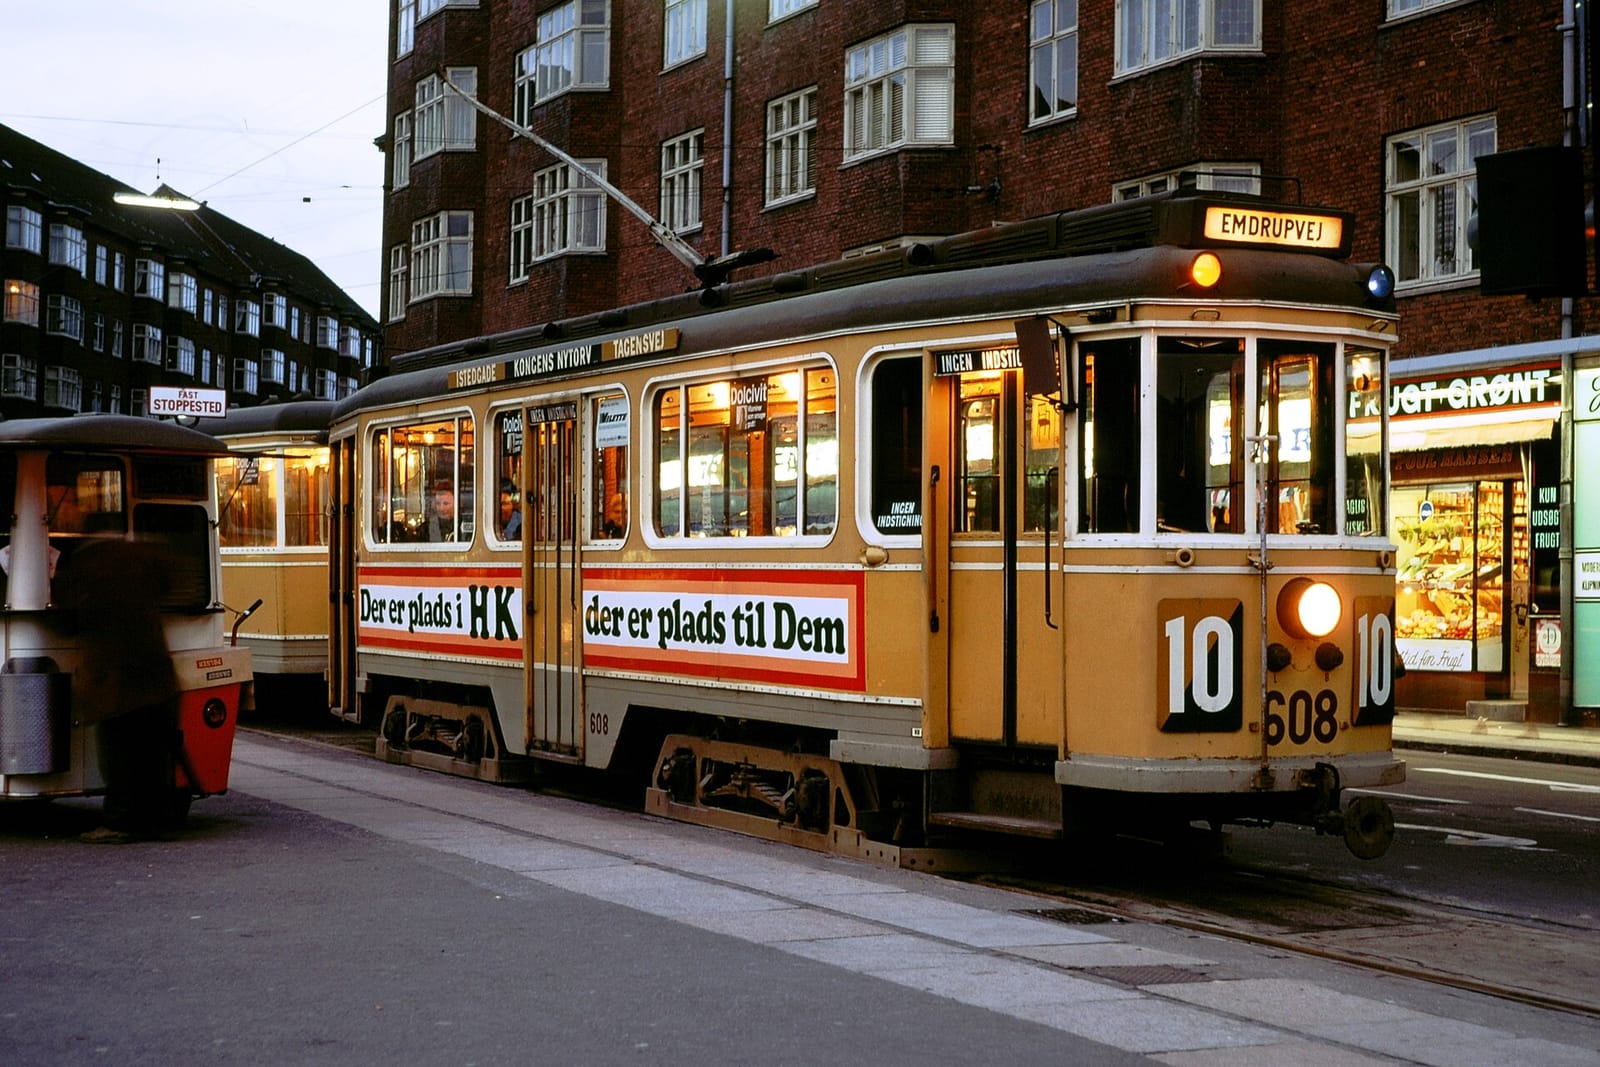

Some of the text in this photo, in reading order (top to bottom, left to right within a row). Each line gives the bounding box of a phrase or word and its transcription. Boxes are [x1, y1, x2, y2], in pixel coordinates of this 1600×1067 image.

[1221, 213, 1323, 242] EMDRUPVEJ
[613, 330, 665, 359] TAGENSVEJ
[513, 345, 592, 378] KONGENS NYTORV
[941, 352, 973, 373] INGEN
[455, 363, 497, 388] ISTEDGADE
[1448, 369, 1550, 409] GRØNT
[153, 399, 222, 413] STOPPESTED
[178, 391, 199, 400] FAST
[730, 382, 767, 406] Dolcivit
[891, 501, 915, 514] INGEN
[1539, 486, 1557, 504] KUN
[1535, 532, 1560, 549] FRUGT
[360, 584, 519, 641] Der er plads i HK
[586, 595, 846, 655] der er plads til Dem
[1165, 615, 1234, 713] 10
[1358, 613, 1391, 707] 10
[590, 713, 609, 736] 608
[1265, 689, 1338, 746] 608
